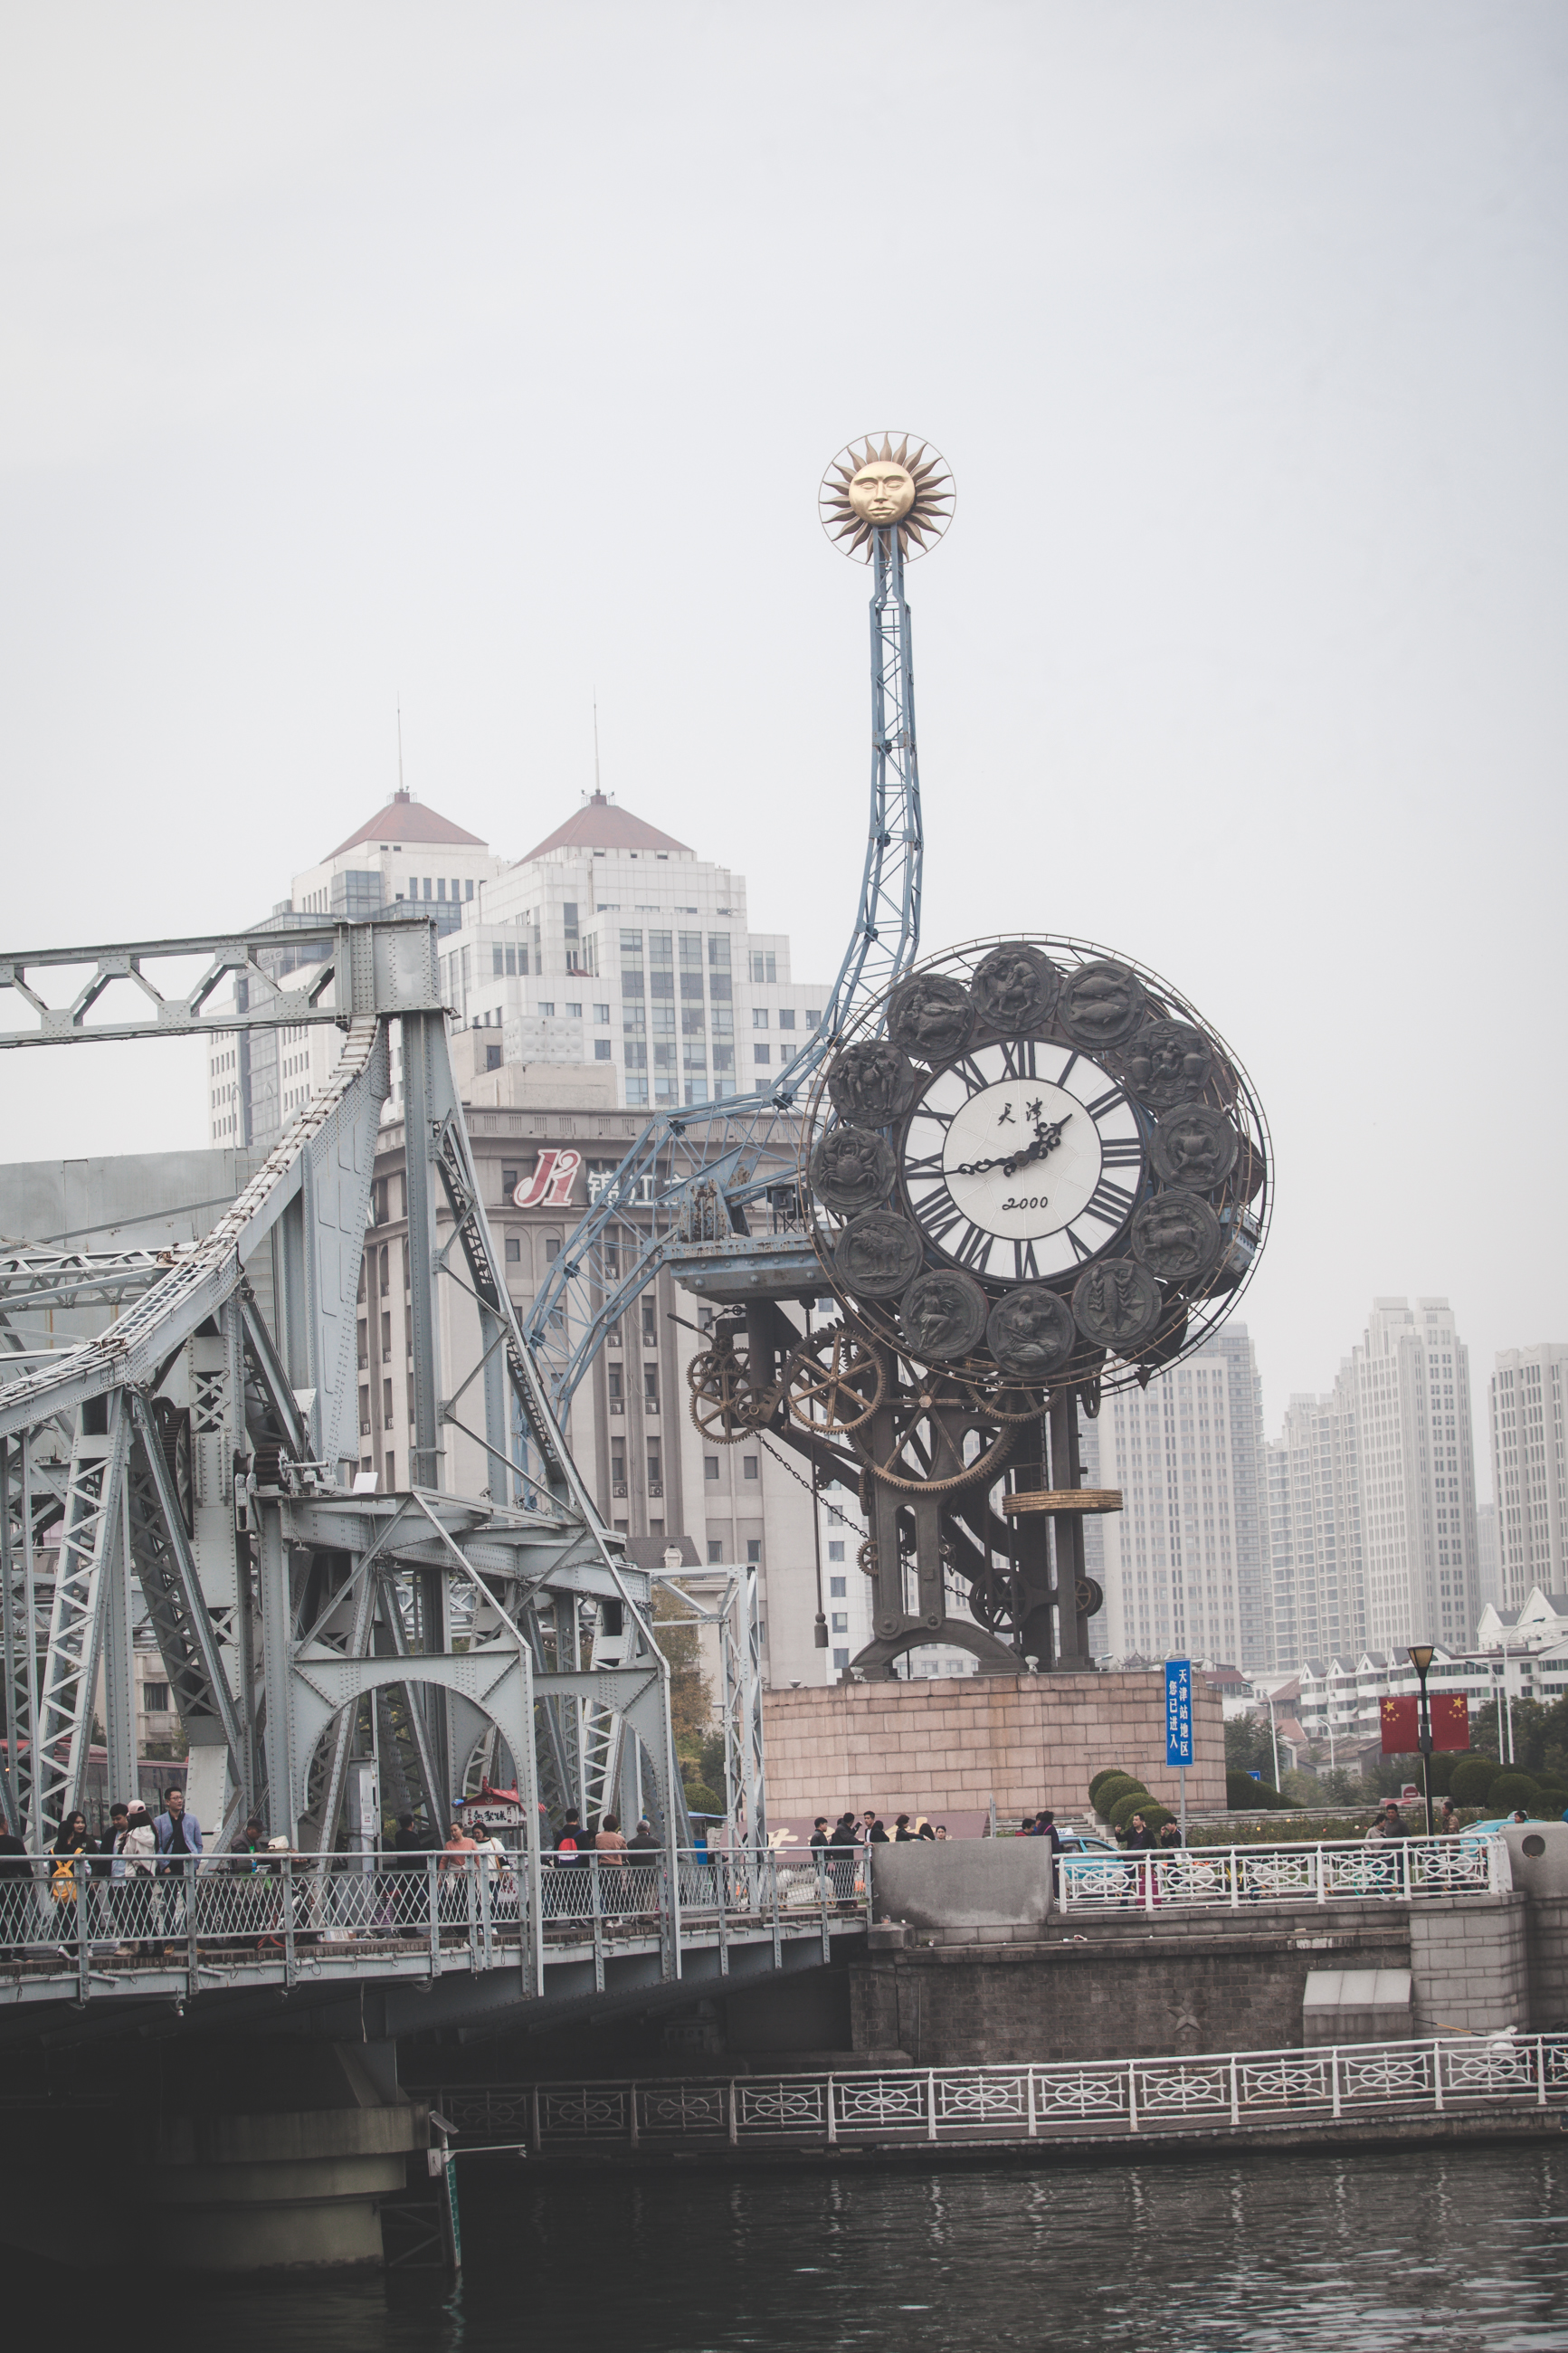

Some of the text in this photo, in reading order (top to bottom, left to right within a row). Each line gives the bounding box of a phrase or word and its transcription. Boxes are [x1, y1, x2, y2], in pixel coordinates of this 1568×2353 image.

[948, 1056, 989, 1100] XI
[1001, 1040, 1036, 1080] XII
[997, 1097, 1043, 1127] 天津
[1101, 1138, 1142, 1168] III
[1002, 1196, 1050, 1211] 2000
[1169, 1681, 1178, 1749] 您已进入
[1178, 1669, 1188, 1757] 天津站地区
